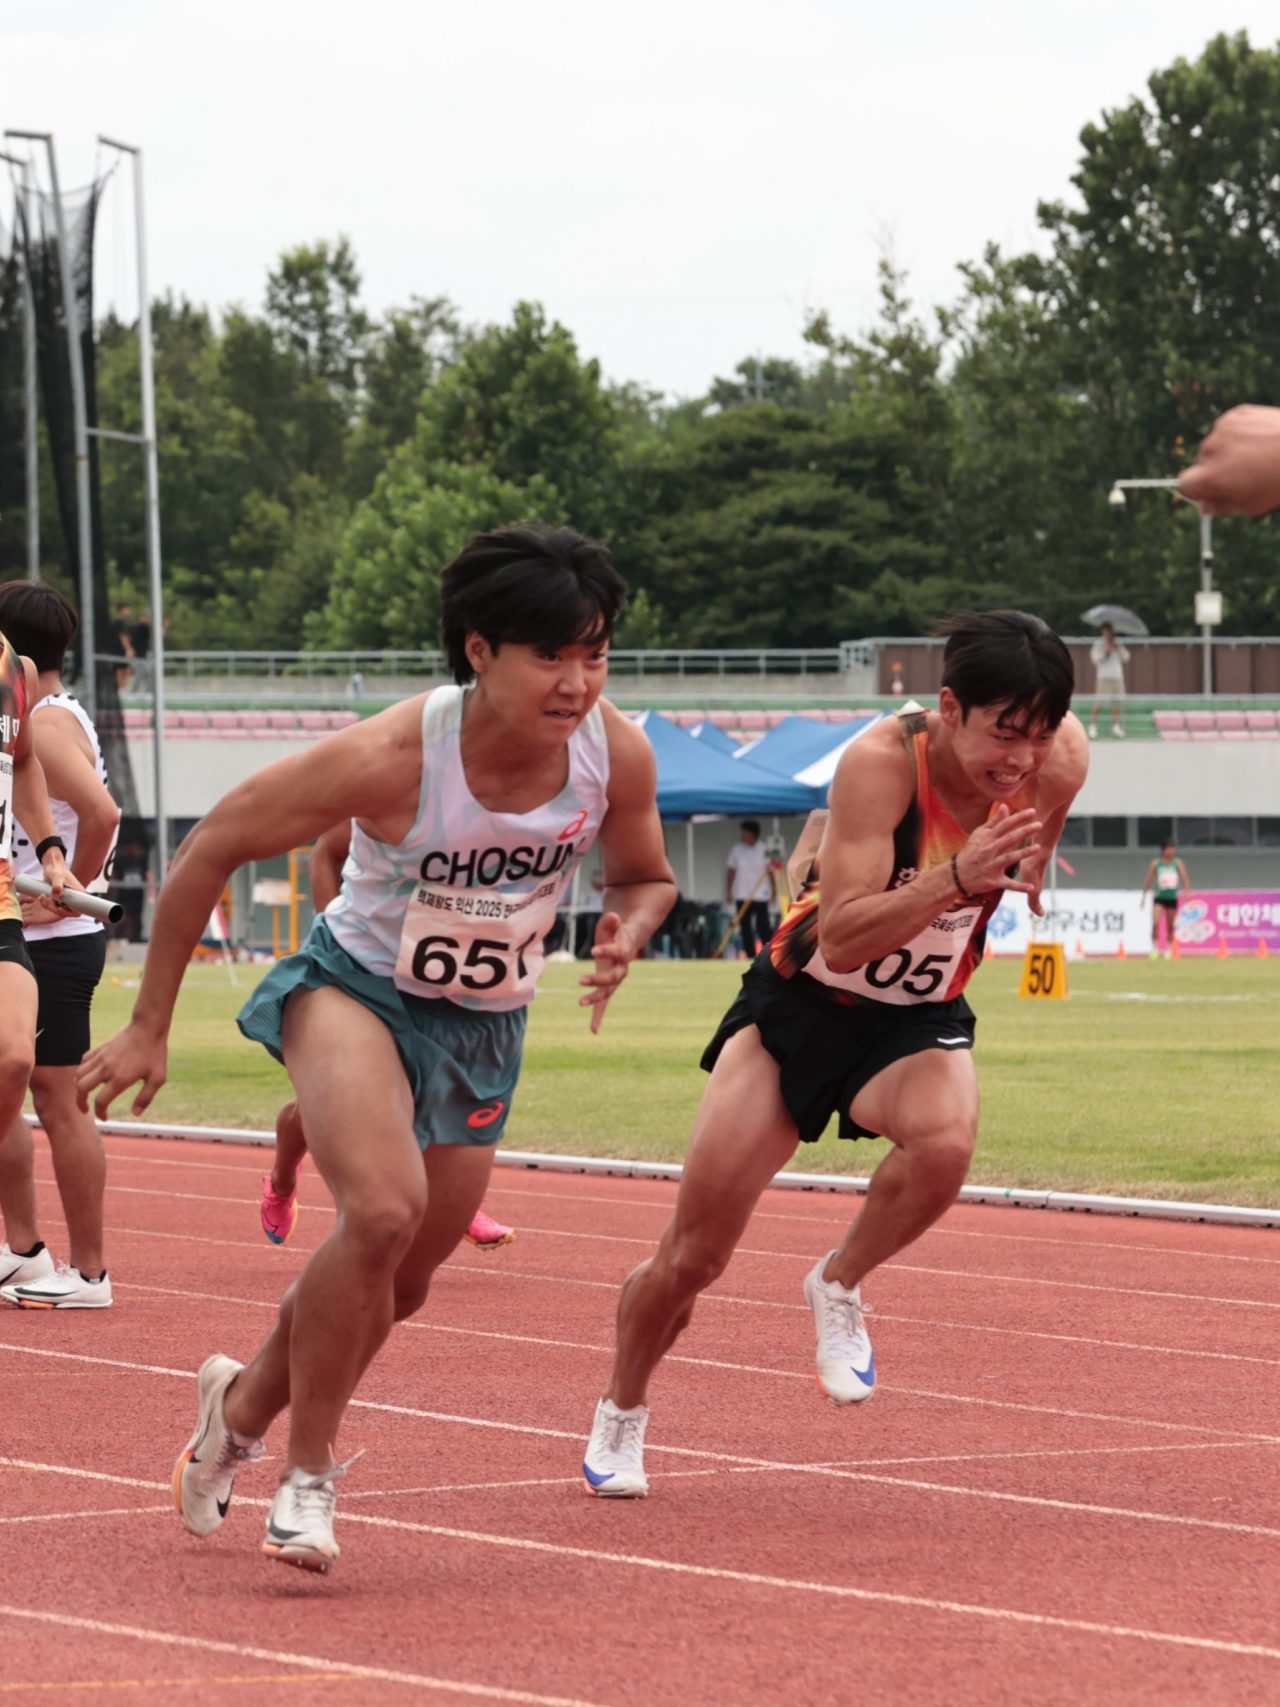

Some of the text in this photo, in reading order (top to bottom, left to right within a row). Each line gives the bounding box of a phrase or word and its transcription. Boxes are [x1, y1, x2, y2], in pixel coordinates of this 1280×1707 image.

[475, 899, 502, 919] 2025
[826, 948, 953, 996] 05
[1029, 953, 1055, 994] 50
